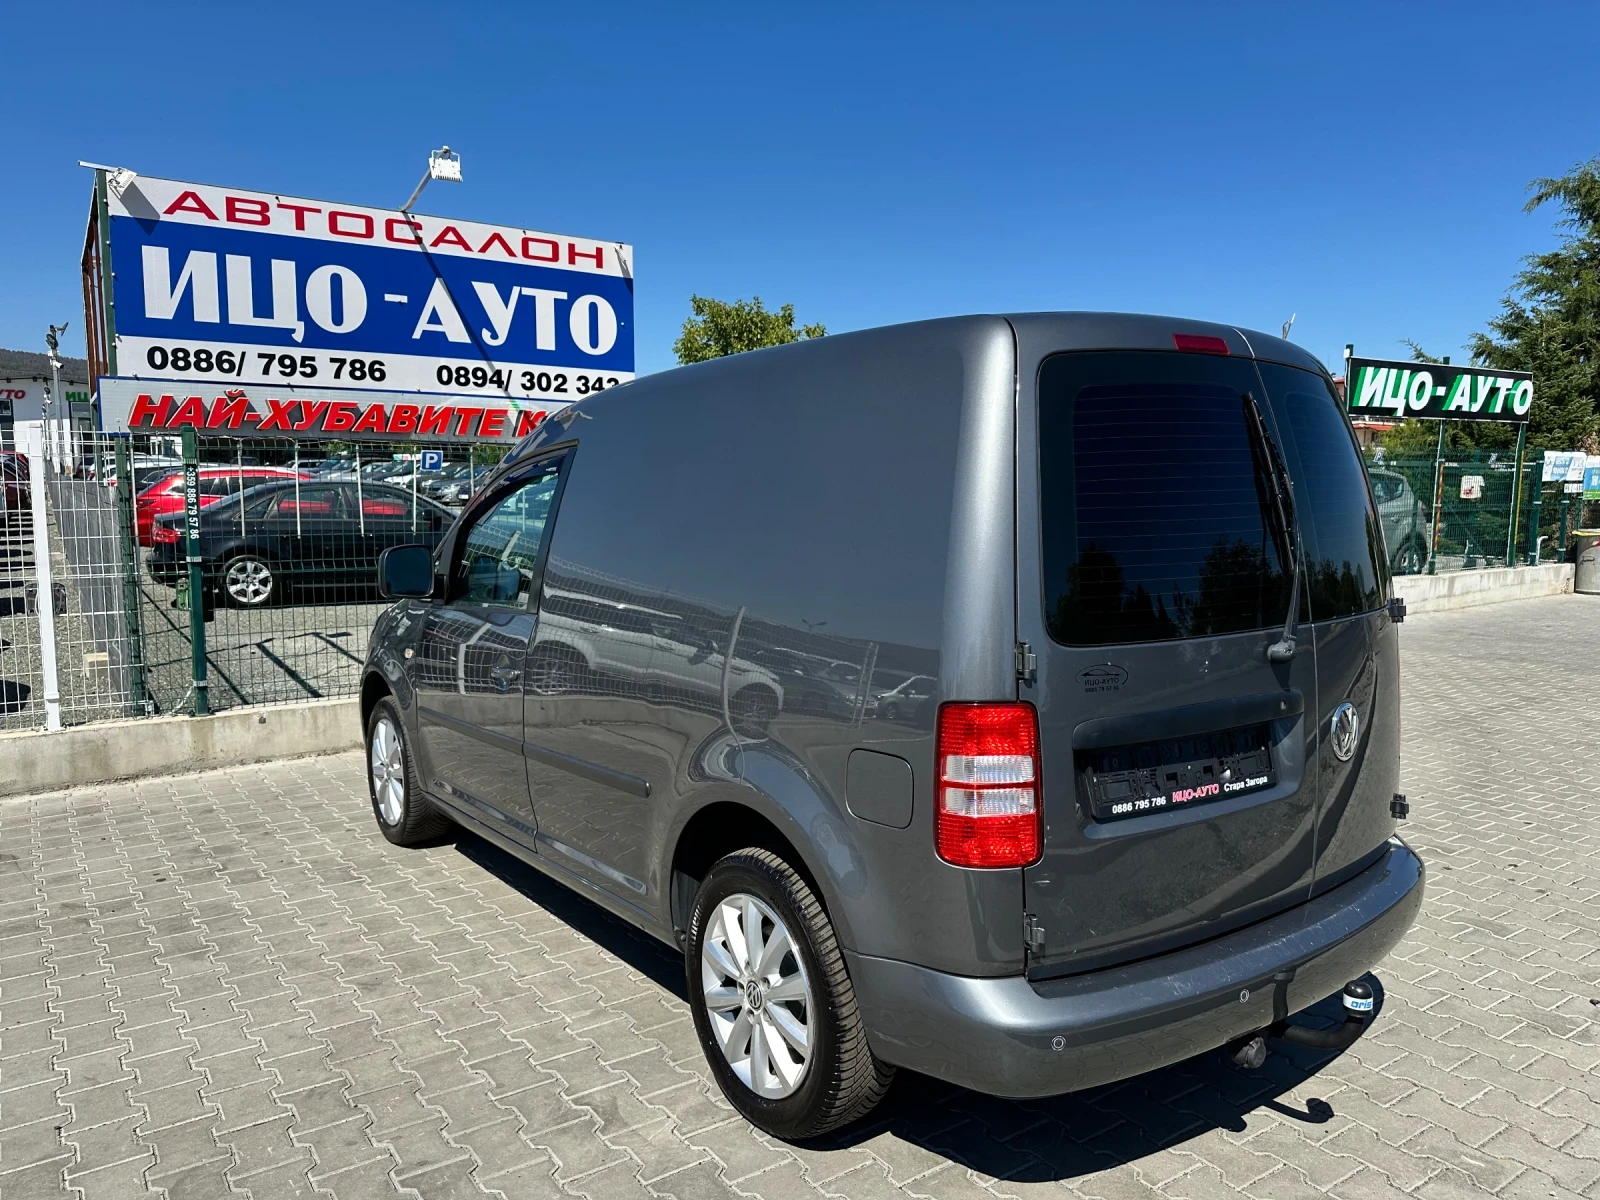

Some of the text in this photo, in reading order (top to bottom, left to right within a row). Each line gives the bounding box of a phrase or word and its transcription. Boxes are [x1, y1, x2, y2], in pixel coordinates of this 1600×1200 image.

[163, 190, 604, 269] АВТОСАЛОН
[147, 346, 387, 382] 0886/ 795 786
[436, 365, 513, 391] 0894/
[520, 371, 568, 393] 302
[0, 389, 26, 400] ТО
[1353, 366, 1534, 417] ИЦО-АУТО
[127, 388, 511, 438] НАЙ-ХУБАВИТЕ
[425, 453, 438, 469] P
[187, 467, 200, 540] +359 886 79 57 86
[1085, 678, 1119, 686] ИЦО-АУТО
[1172, 783, 1220, 803] ИЦО-АУТО
[1223, 775, 1268, 792] Стара Загора
[1112, 796, 1167, 814] 0886 795 786
